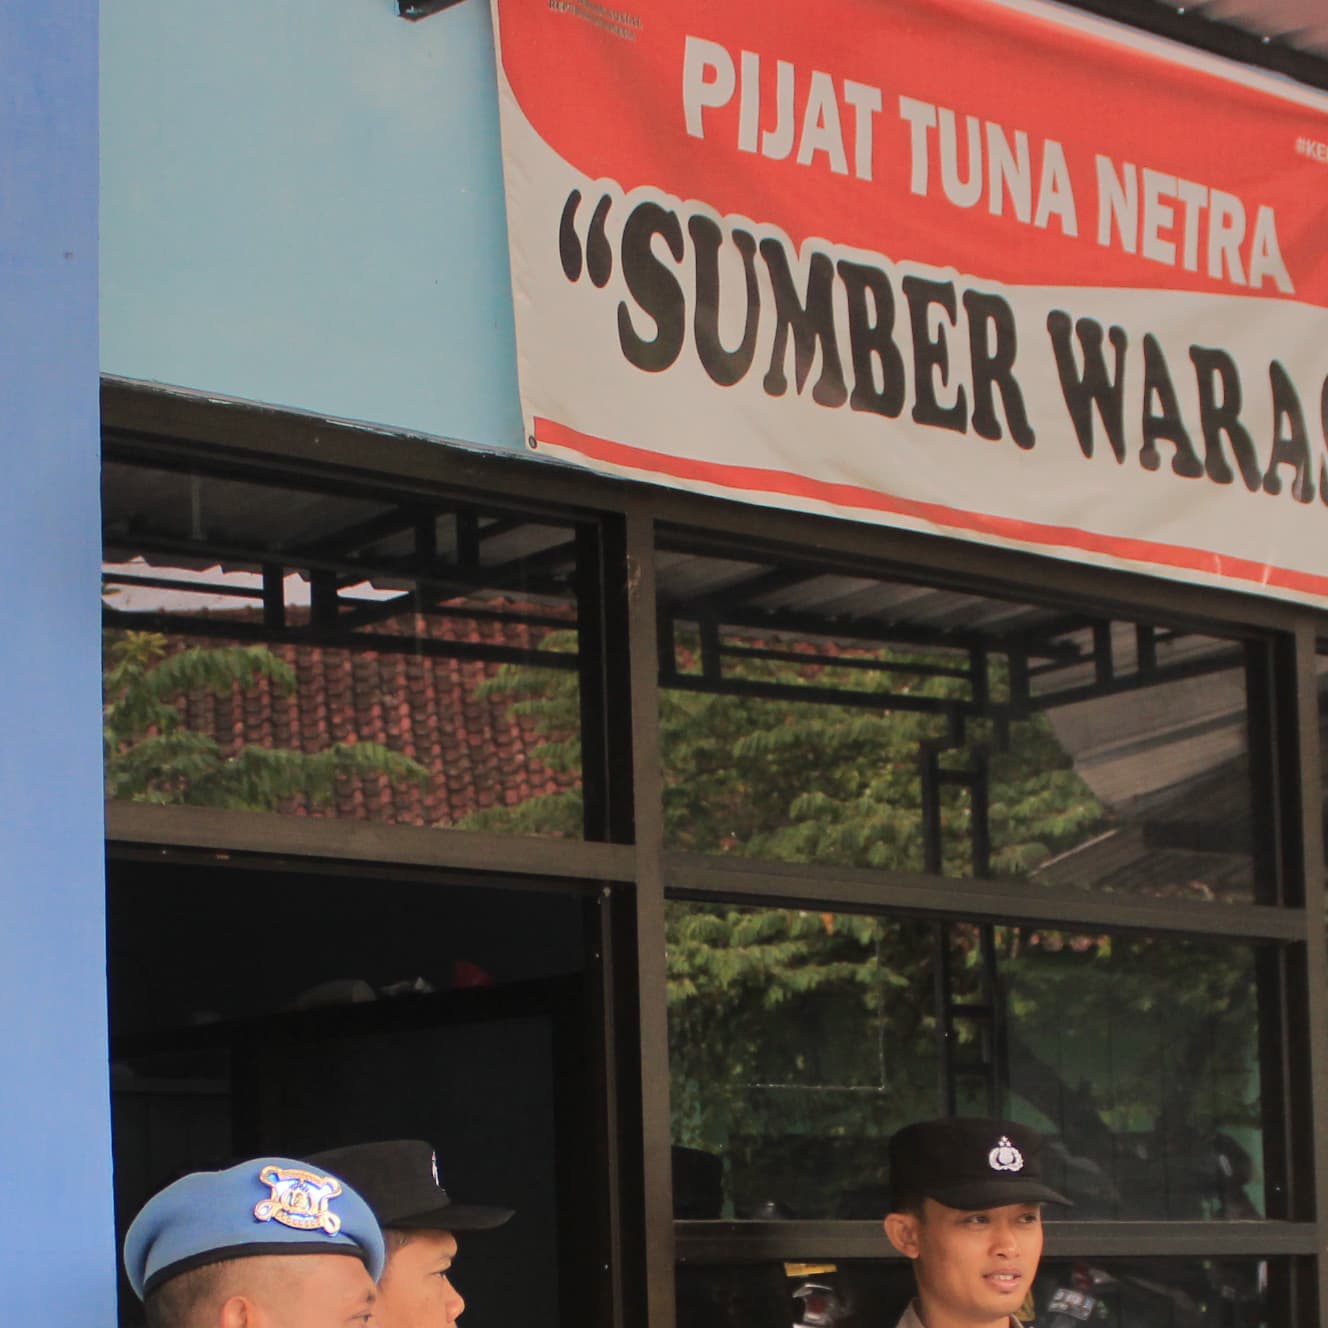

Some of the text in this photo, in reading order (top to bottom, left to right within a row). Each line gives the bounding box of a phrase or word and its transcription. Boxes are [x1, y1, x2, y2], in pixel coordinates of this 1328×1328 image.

[682, 35, 1295, 294] PIJAT TUNA NETRA
